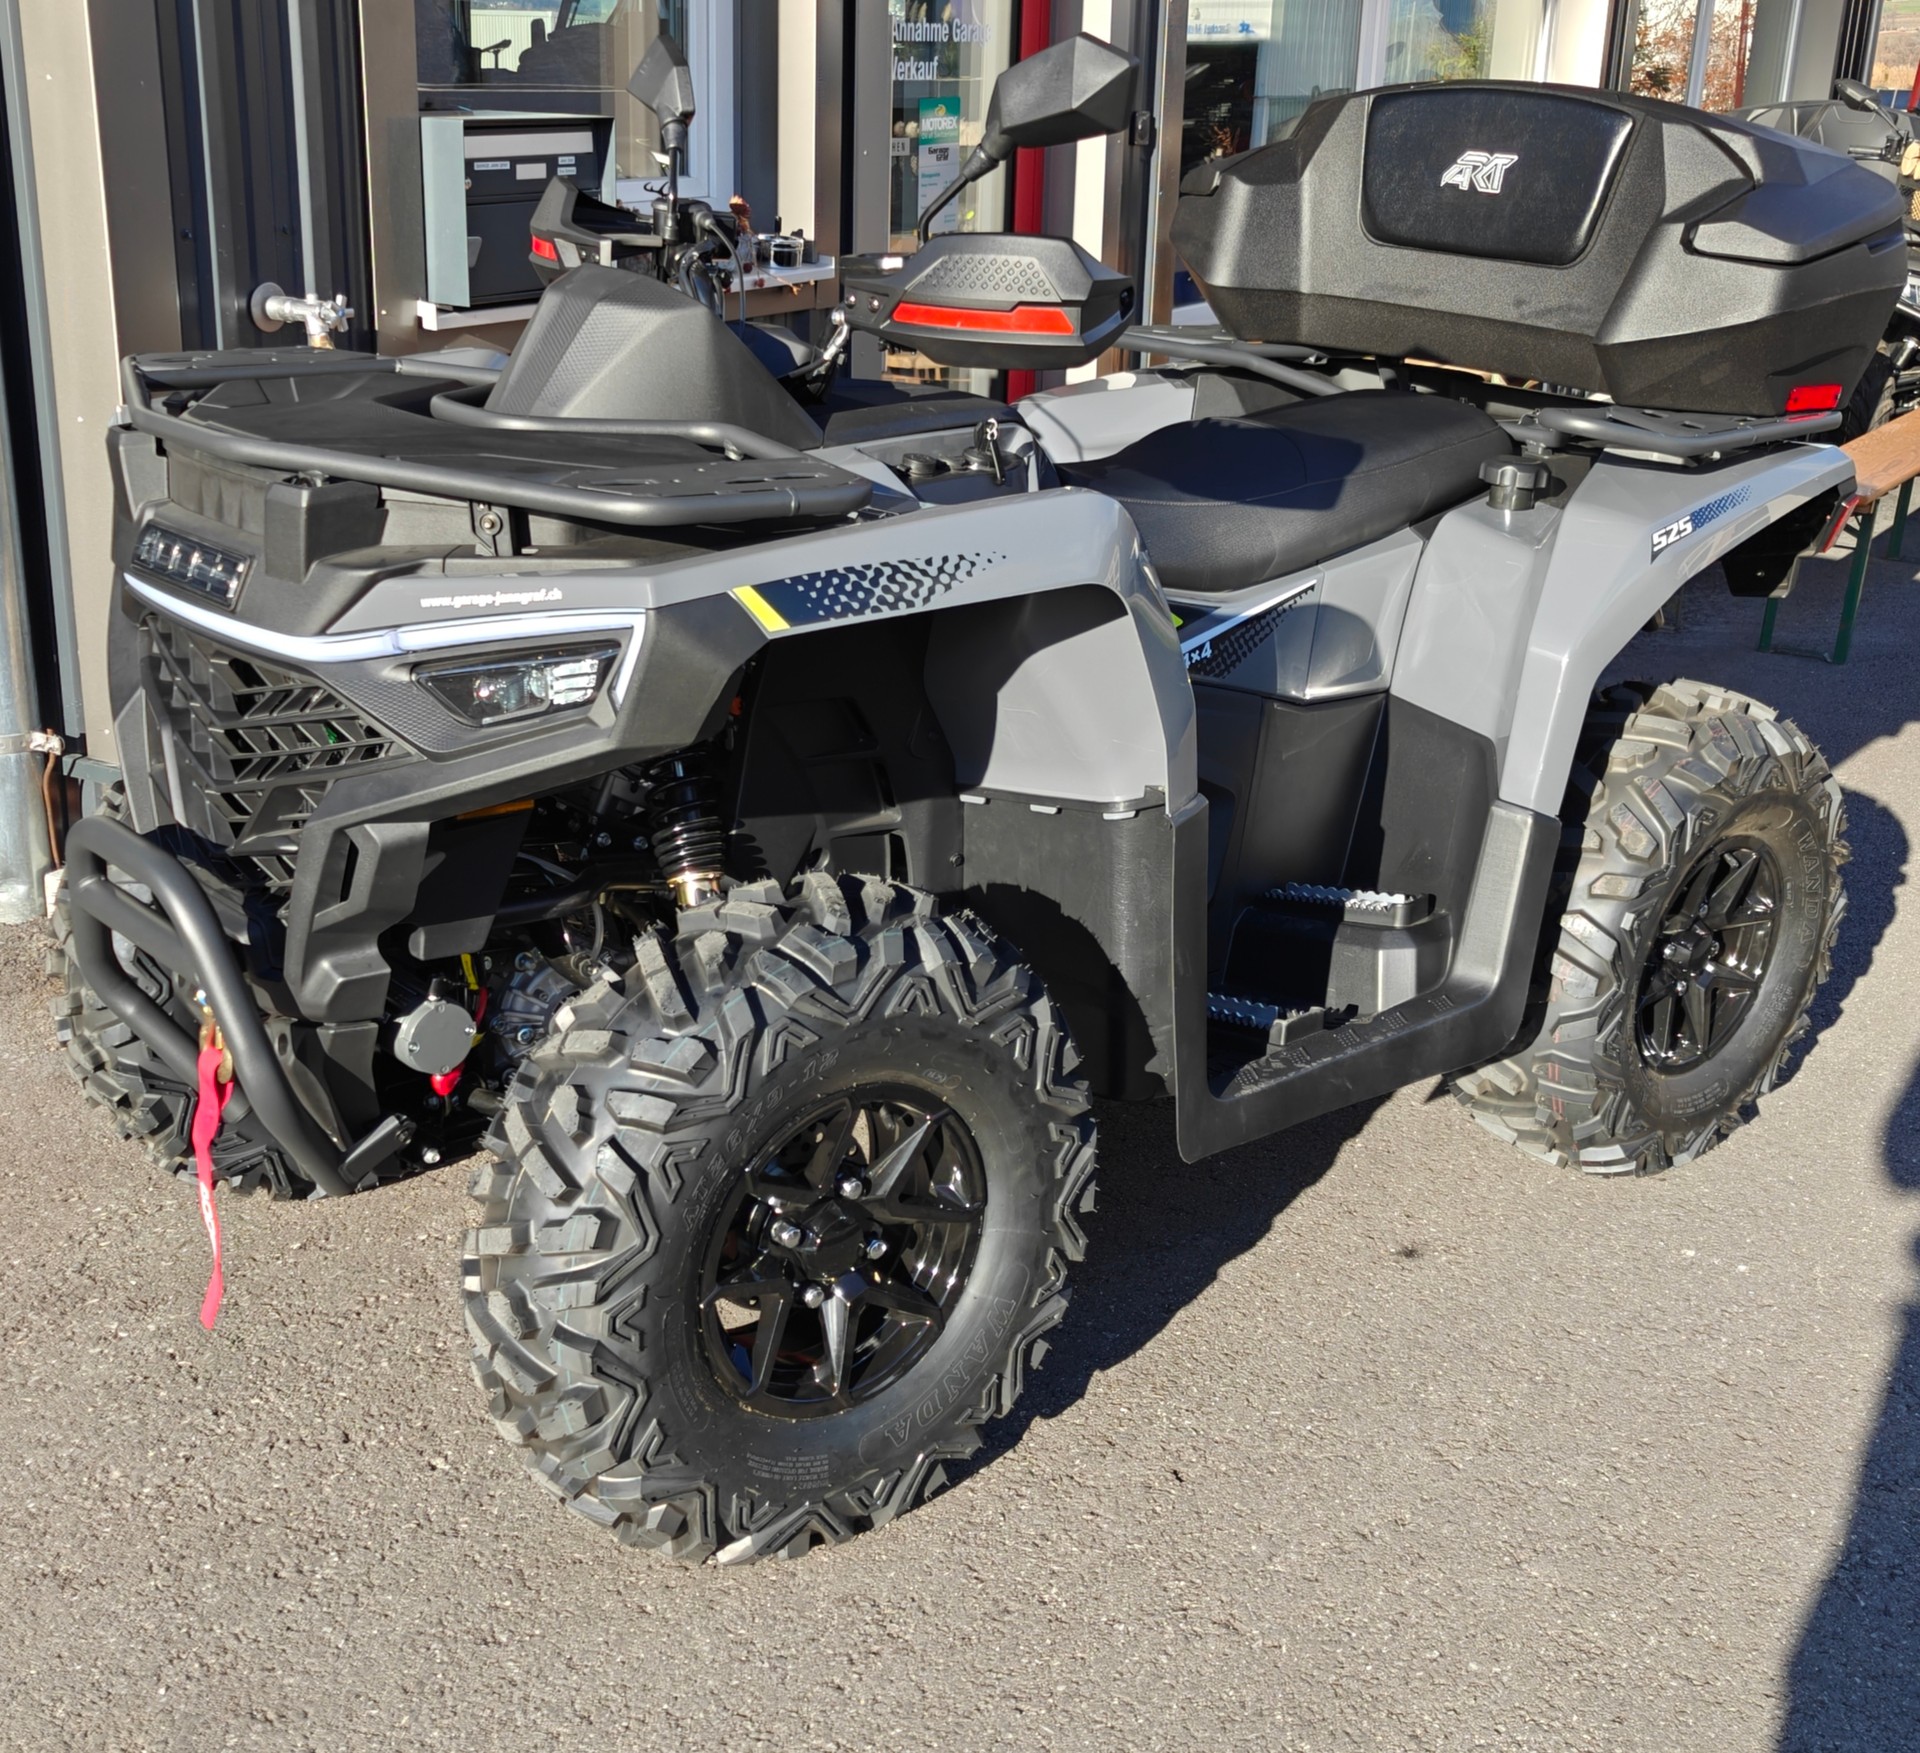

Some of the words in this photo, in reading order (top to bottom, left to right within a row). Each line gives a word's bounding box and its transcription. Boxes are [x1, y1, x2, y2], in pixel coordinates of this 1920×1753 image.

[893, 18, 950, 42] Annahme
[921, 116, 958, 132] MOTOREX
[1652, 515, 1693, 552] 525
[1797, 830, 1822, 944] WANDA
[885, 1297, 1017, 1448] WANDA
